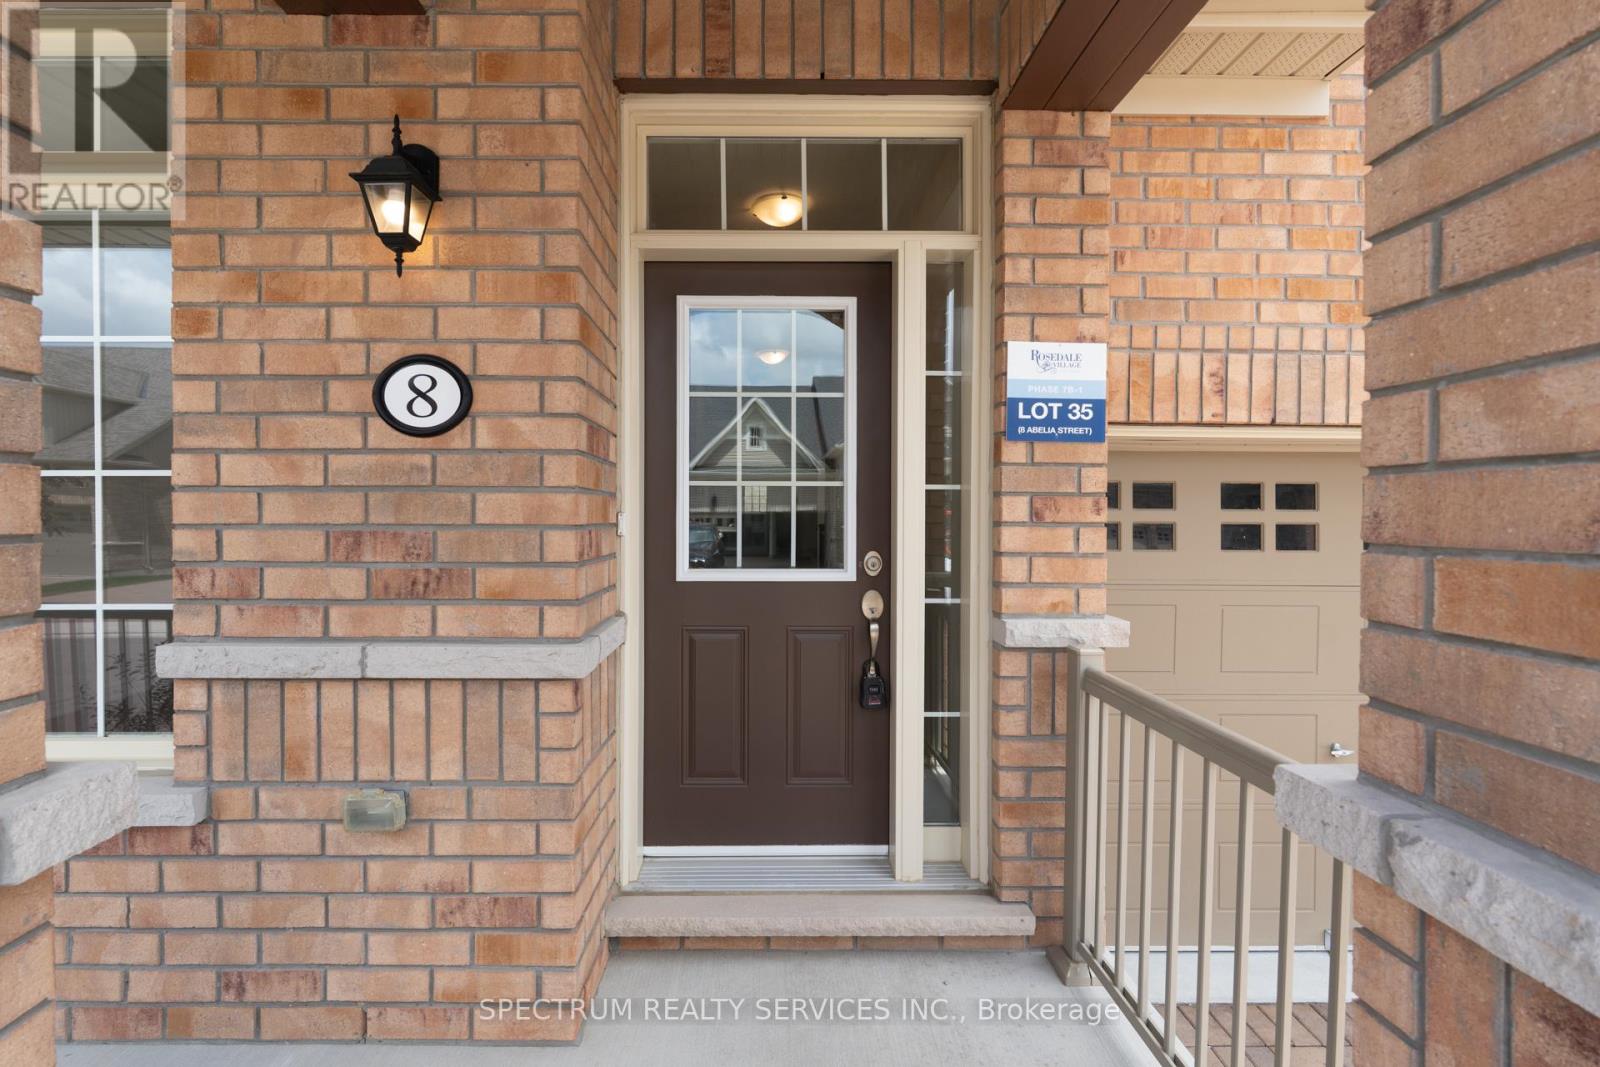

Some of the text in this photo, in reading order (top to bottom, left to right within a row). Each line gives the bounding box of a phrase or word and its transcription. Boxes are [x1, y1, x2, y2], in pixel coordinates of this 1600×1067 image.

[406, 373, 438, 418] 8
[1028, 385, 1059, 393] PHASE
[1018, 402, 1094, 421] LOT 35
[1057, 427, 1093, 436] STREET)
